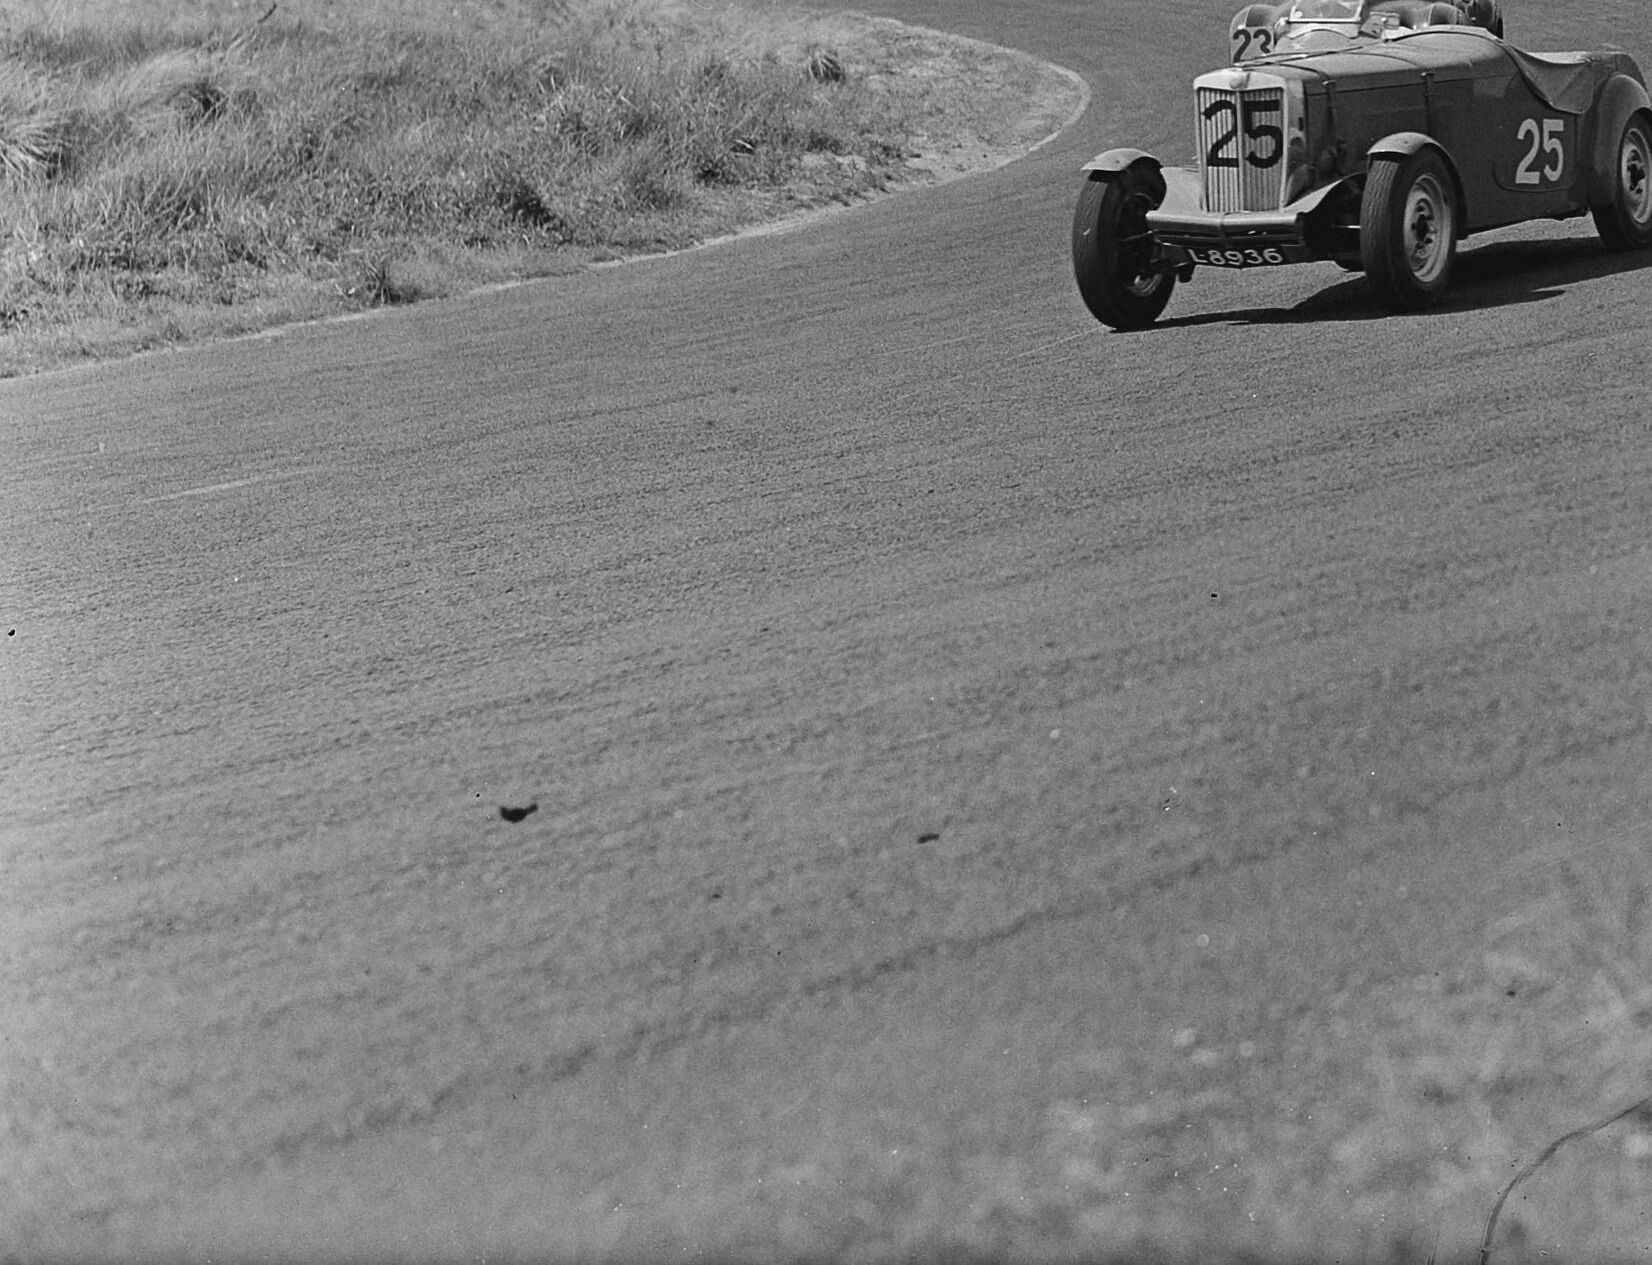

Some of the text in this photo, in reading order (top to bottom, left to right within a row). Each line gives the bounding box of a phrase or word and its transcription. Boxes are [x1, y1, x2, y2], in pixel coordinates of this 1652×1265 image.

[1200, 97, 1284, 169] 25
[1514, 118, 1565, 185] 25
[1187, 248, 1284, 266] L-8936
